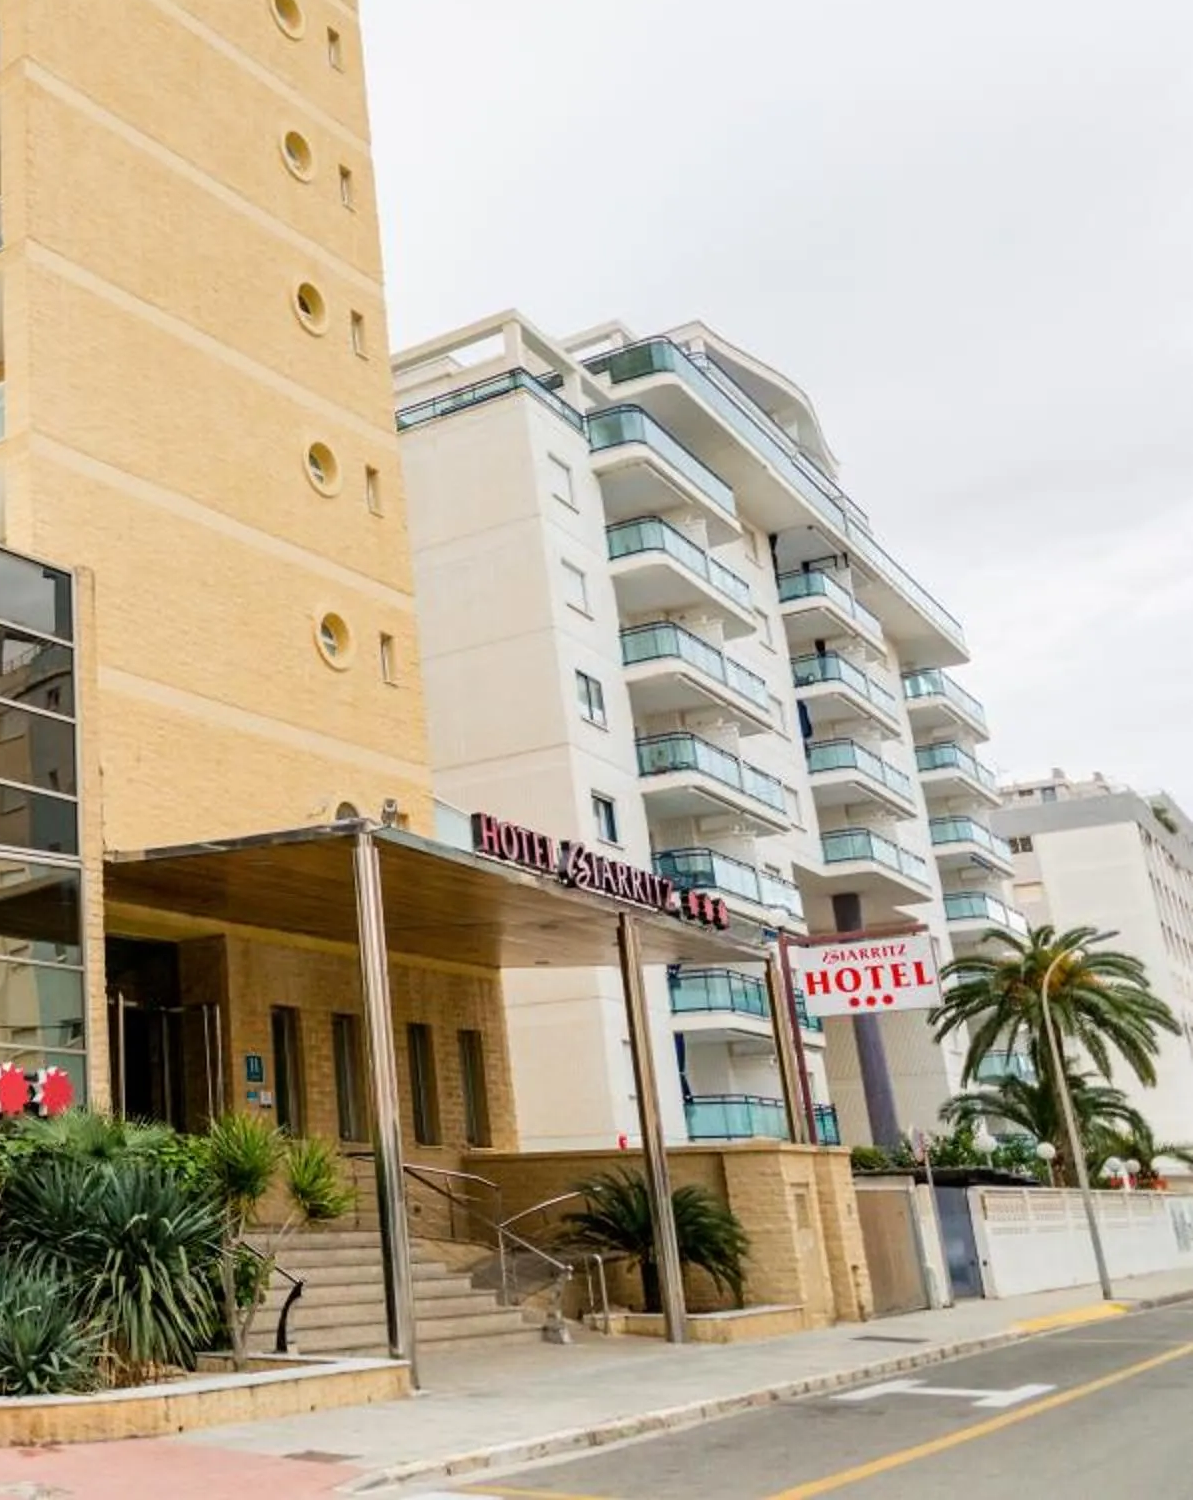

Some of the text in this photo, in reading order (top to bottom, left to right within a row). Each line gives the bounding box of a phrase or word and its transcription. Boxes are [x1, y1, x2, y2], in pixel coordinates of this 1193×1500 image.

[472, 812, 678, 912] HOTEL BIARRITZ
[822, 943, 906, 964] BIARRITZ
[805, 961, 934, 997] HOTEL
